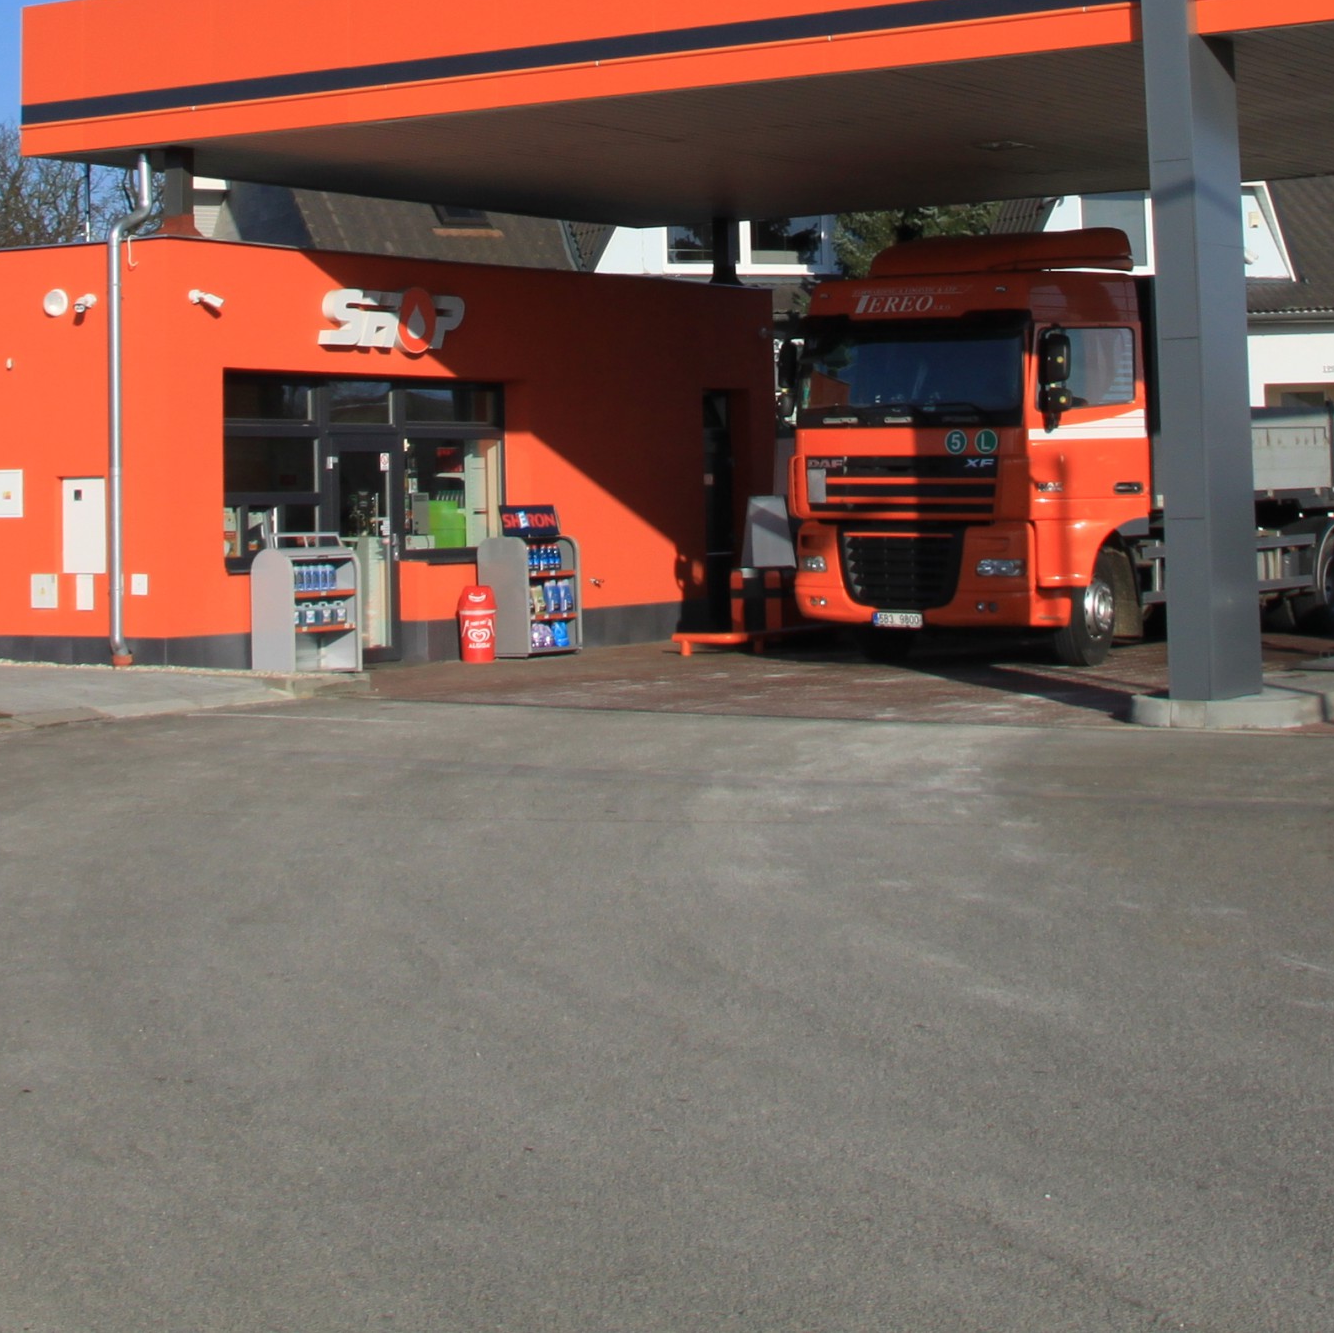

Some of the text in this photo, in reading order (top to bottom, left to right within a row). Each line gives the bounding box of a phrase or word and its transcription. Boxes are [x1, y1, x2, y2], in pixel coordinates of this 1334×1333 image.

[317, 287, 466, 354] SHOP
[951, 435, 961, 450] 5
[981, 435, 991, 450] L
[807, 459, 843, 468] DAF
[964, 458, 995, 468] XF
[501, 511, 557, 528] SHERON
